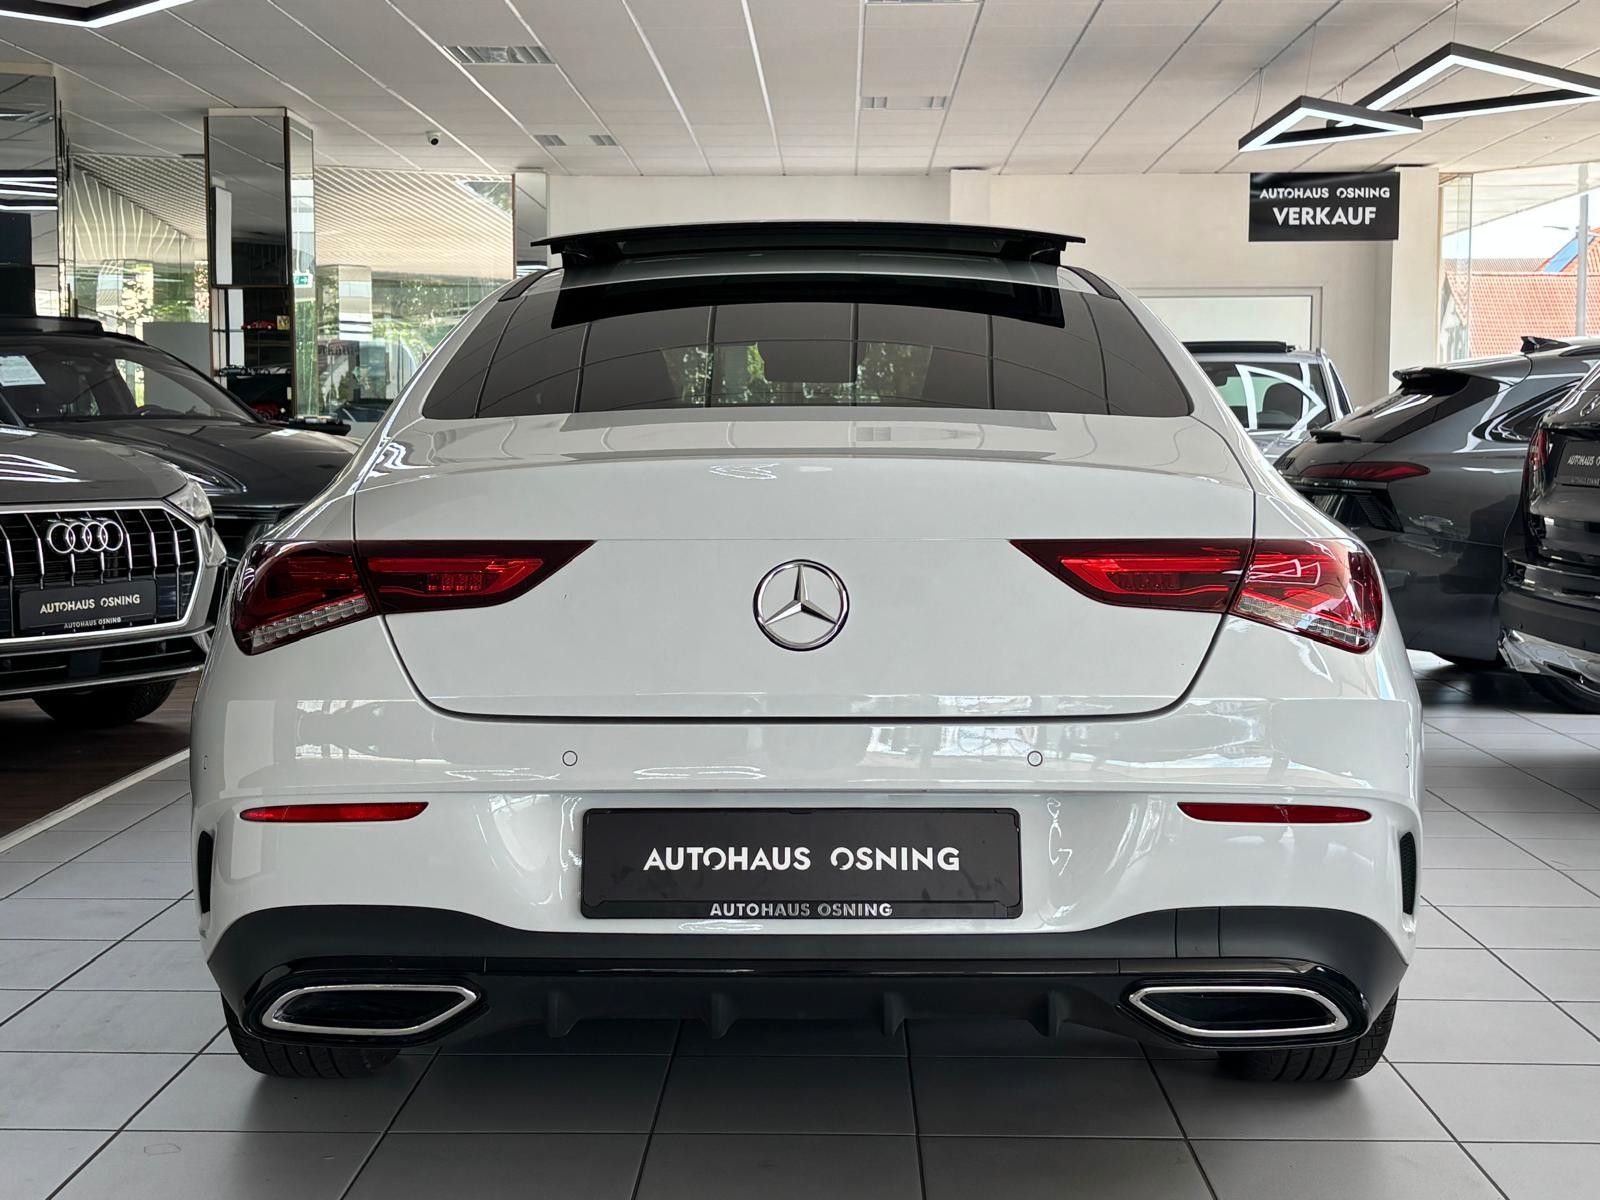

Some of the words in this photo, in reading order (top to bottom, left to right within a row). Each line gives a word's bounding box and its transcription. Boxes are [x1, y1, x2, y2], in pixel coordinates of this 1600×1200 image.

[1260, 188, 1329, 199] AUTOHAUS
[1336, 187, 1390, 199] OSNING
[1272, 206, 1377, 226] VERKAUF
[40, 598, 95, 614] AUTOHAUS
[100, 594, 140, 607] OSNING
[64, 619, 97, 629] AUTOHAUS
[98, 616, 122, 626] OSNING
[643, 847, 811, 872] AUTOHAUS
[830, 847, 960, 872] OSNING
[710, 902, 811, 918] AUTOHAUS
[817, 902, 893, 918] OSNING
